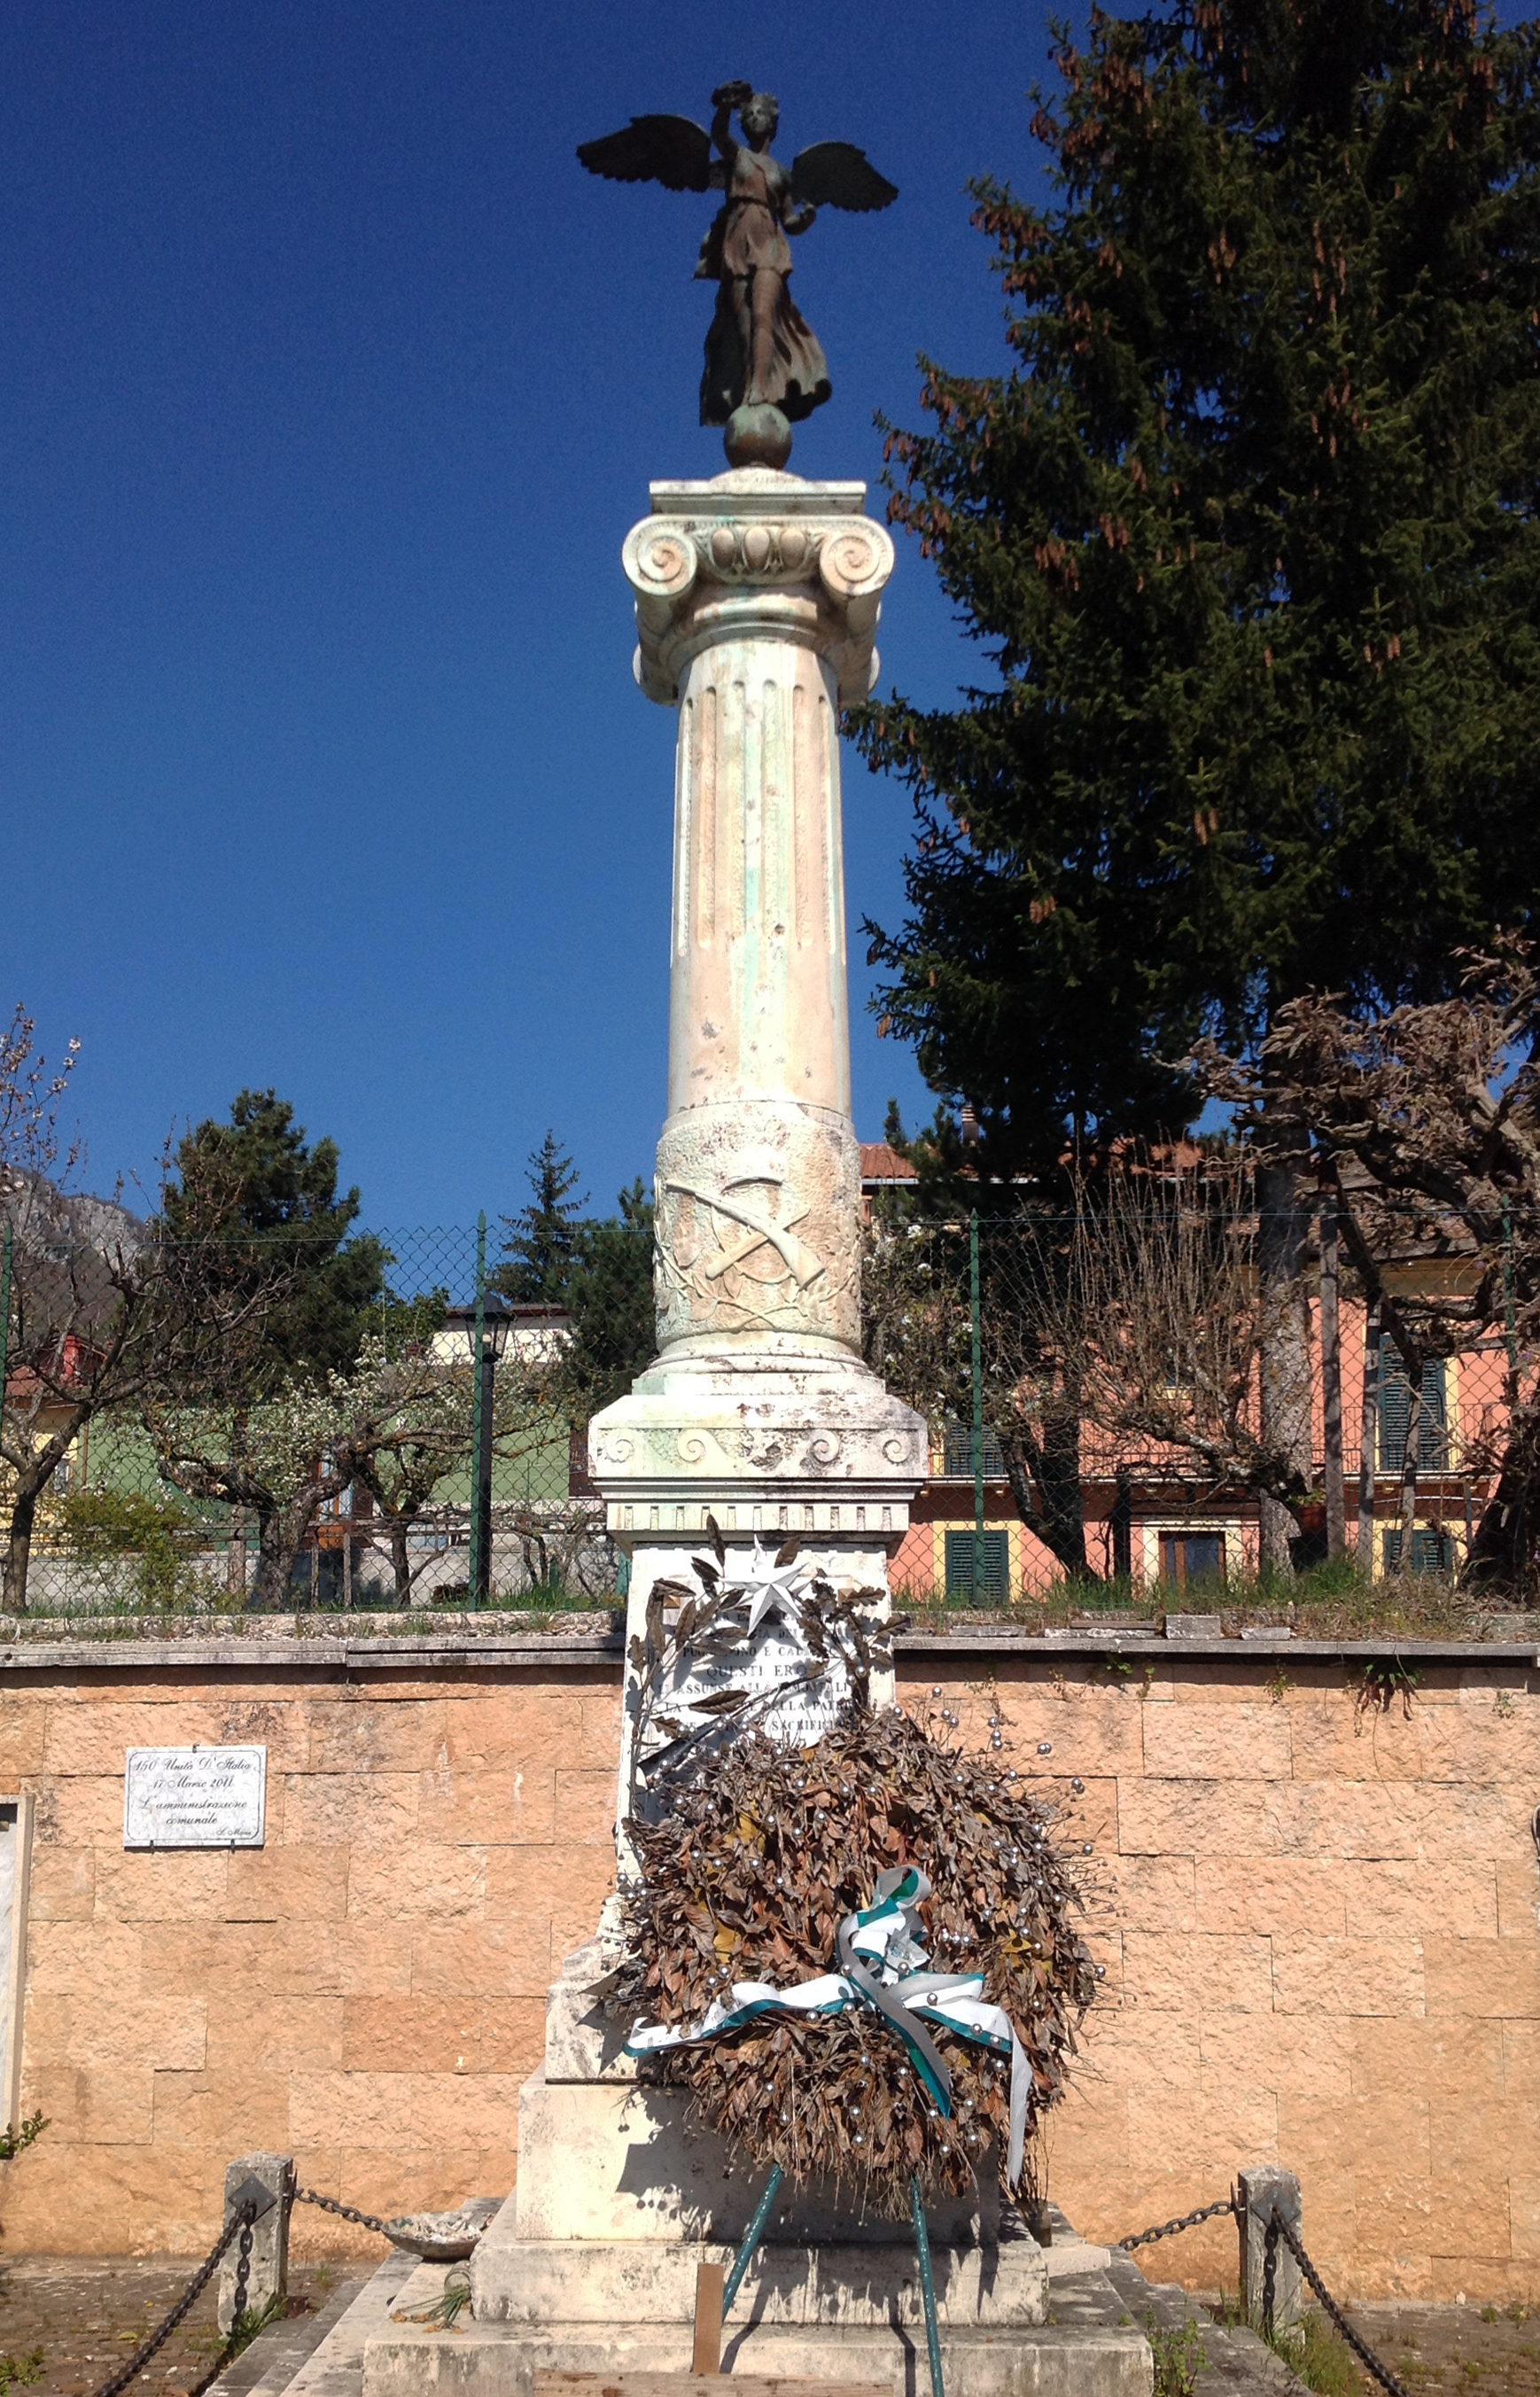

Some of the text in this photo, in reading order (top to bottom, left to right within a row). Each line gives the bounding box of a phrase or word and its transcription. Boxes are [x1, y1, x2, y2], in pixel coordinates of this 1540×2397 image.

[706, 1665, 763, 1677] QUESTI
[210, 1778, 234, 1788] 2011
[166, 1812, 218, 1825] comunale
